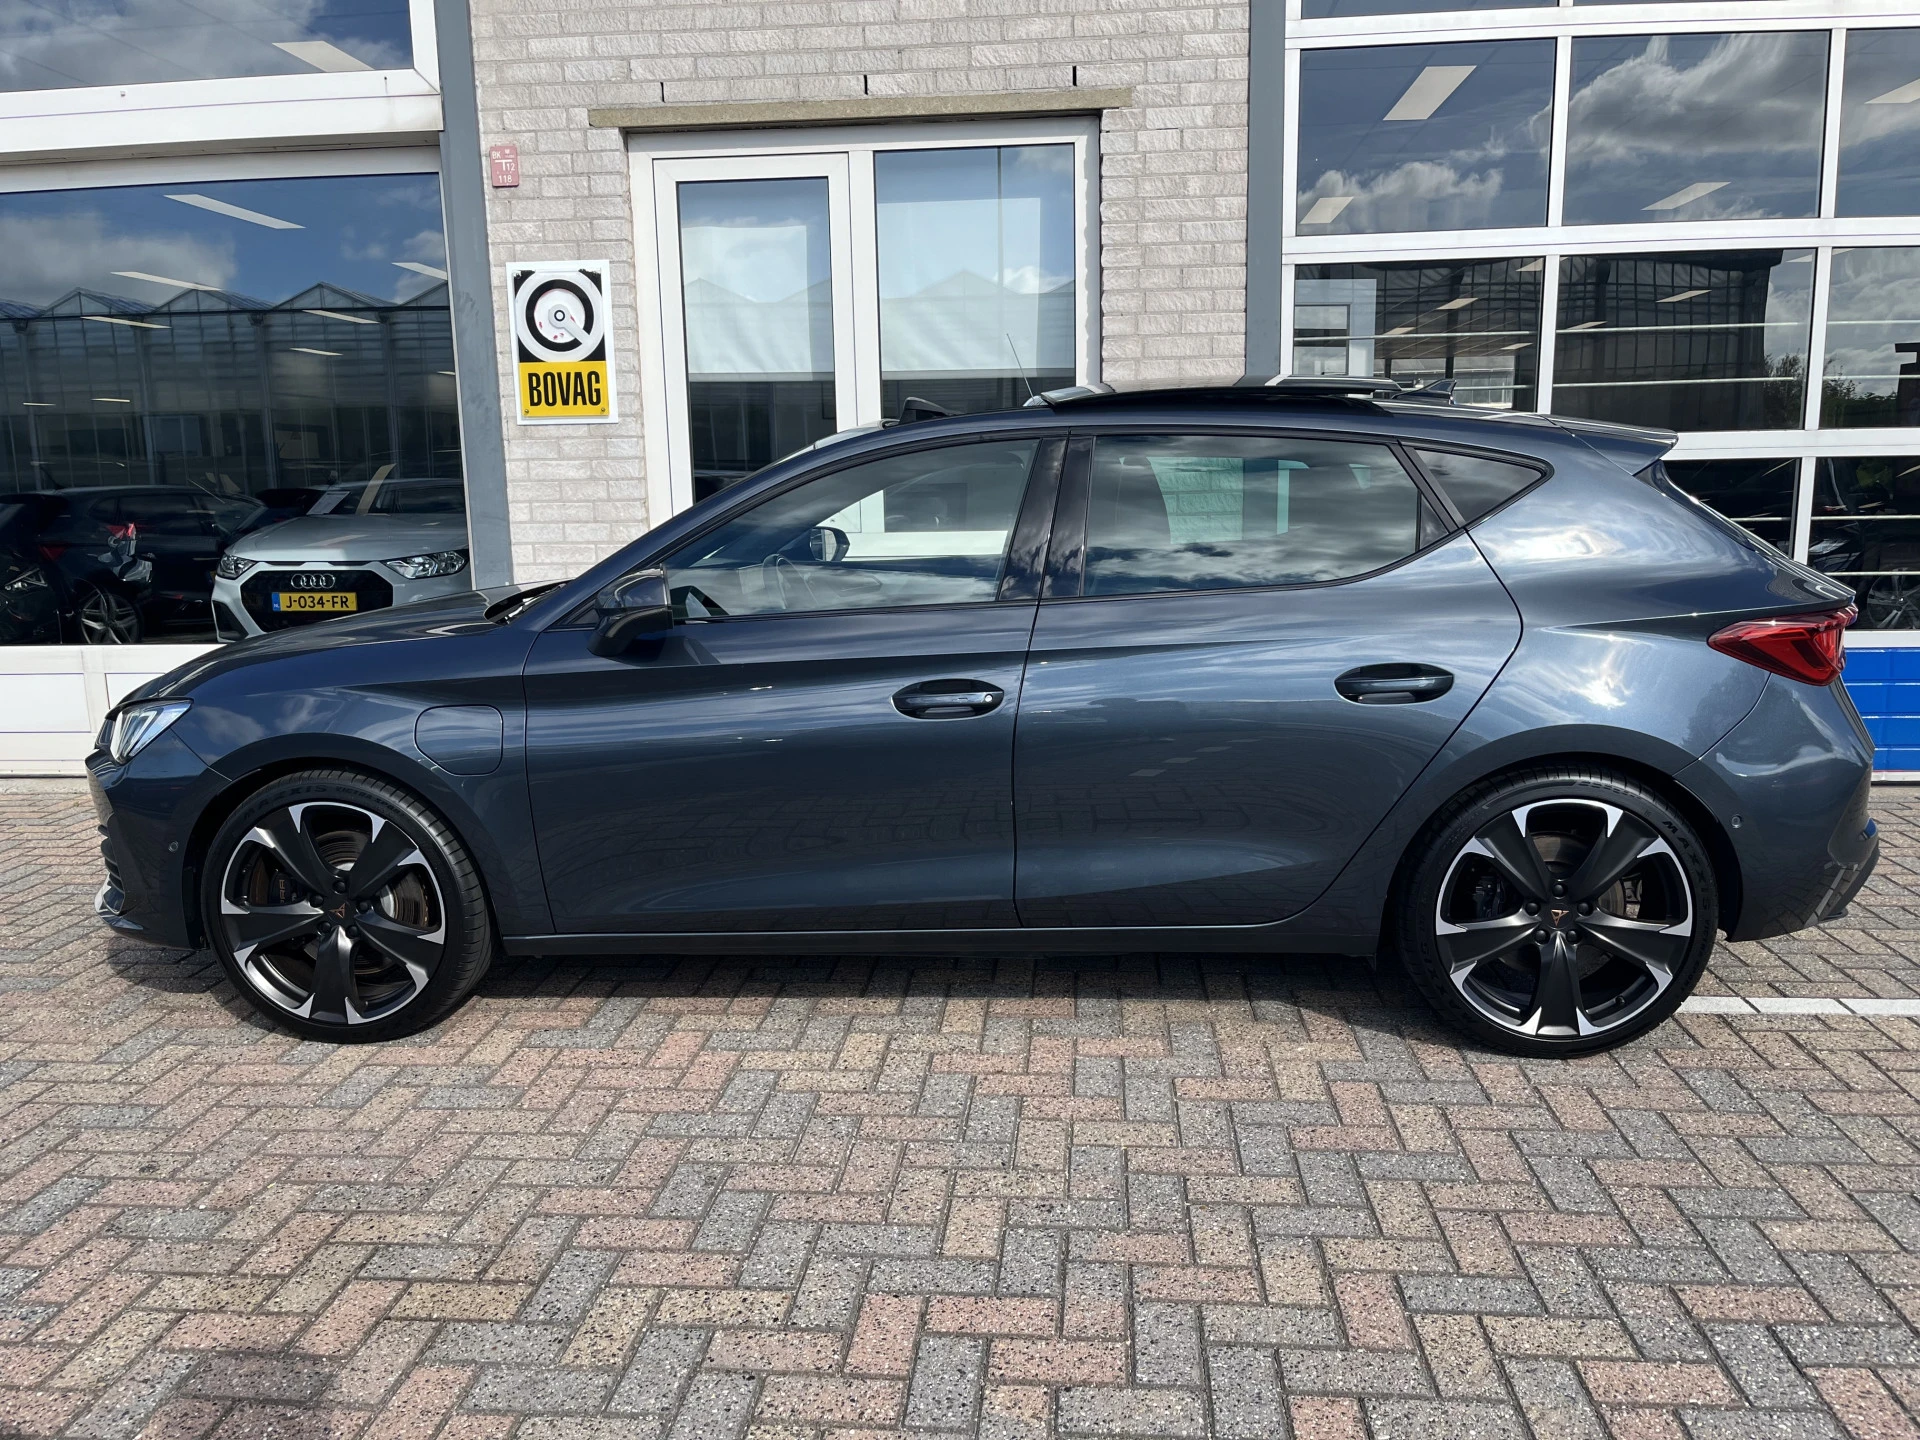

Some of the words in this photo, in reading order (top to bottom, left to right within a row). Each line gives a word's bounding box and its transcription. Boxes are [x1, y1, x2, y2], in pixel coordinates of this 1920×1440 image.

[498, 175, 512, 183] 118
[528, 371, 601, 406] BOVAG
[286, 596, 349, 608] J-034-FR
[243, 785, 328, 820] MAXXIS
[1662, 820, 1711, 909] MAXXIS
